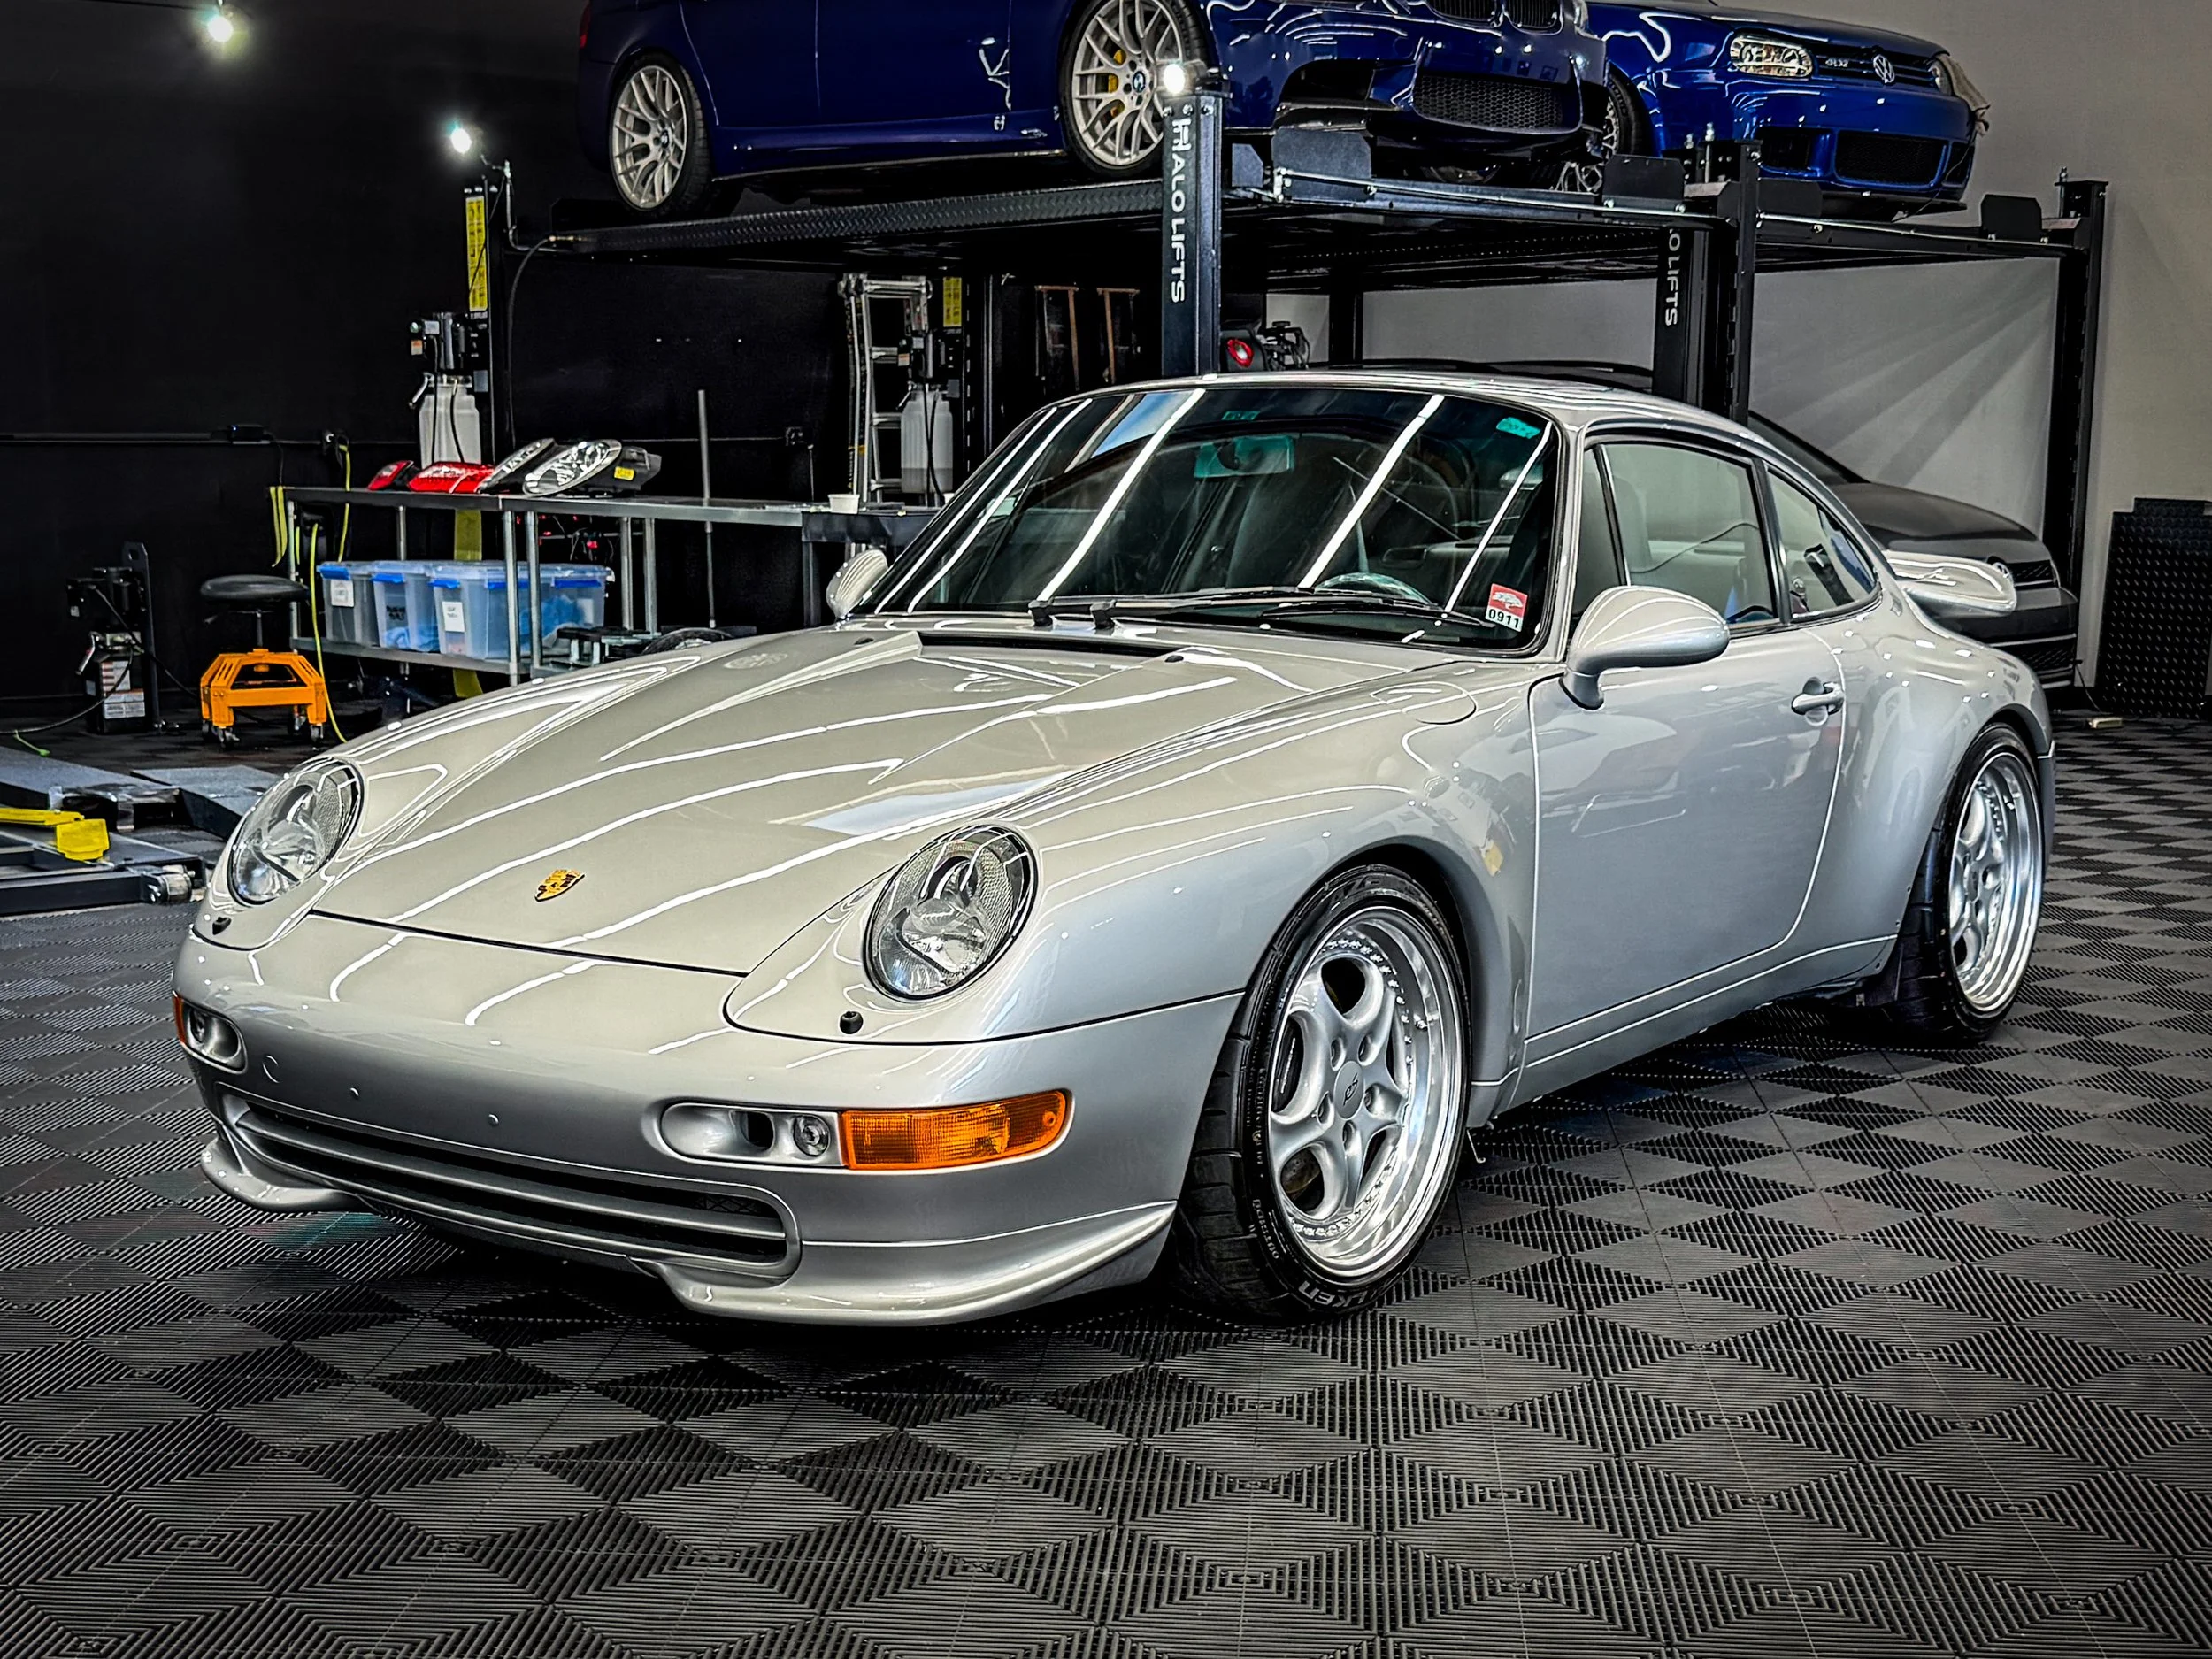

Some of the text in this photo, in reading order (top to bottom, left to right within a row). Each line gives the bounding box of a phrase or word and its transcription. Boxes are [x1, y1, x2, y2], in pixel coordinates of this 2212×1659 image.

[1171, 118, 1192, 303] HALO LIFTS
[1664, 255, 1680, 326] LIFTS
[1488, 609, 1519, 628] 0911
[1298, 1279, 1386, 1308] LKEN
